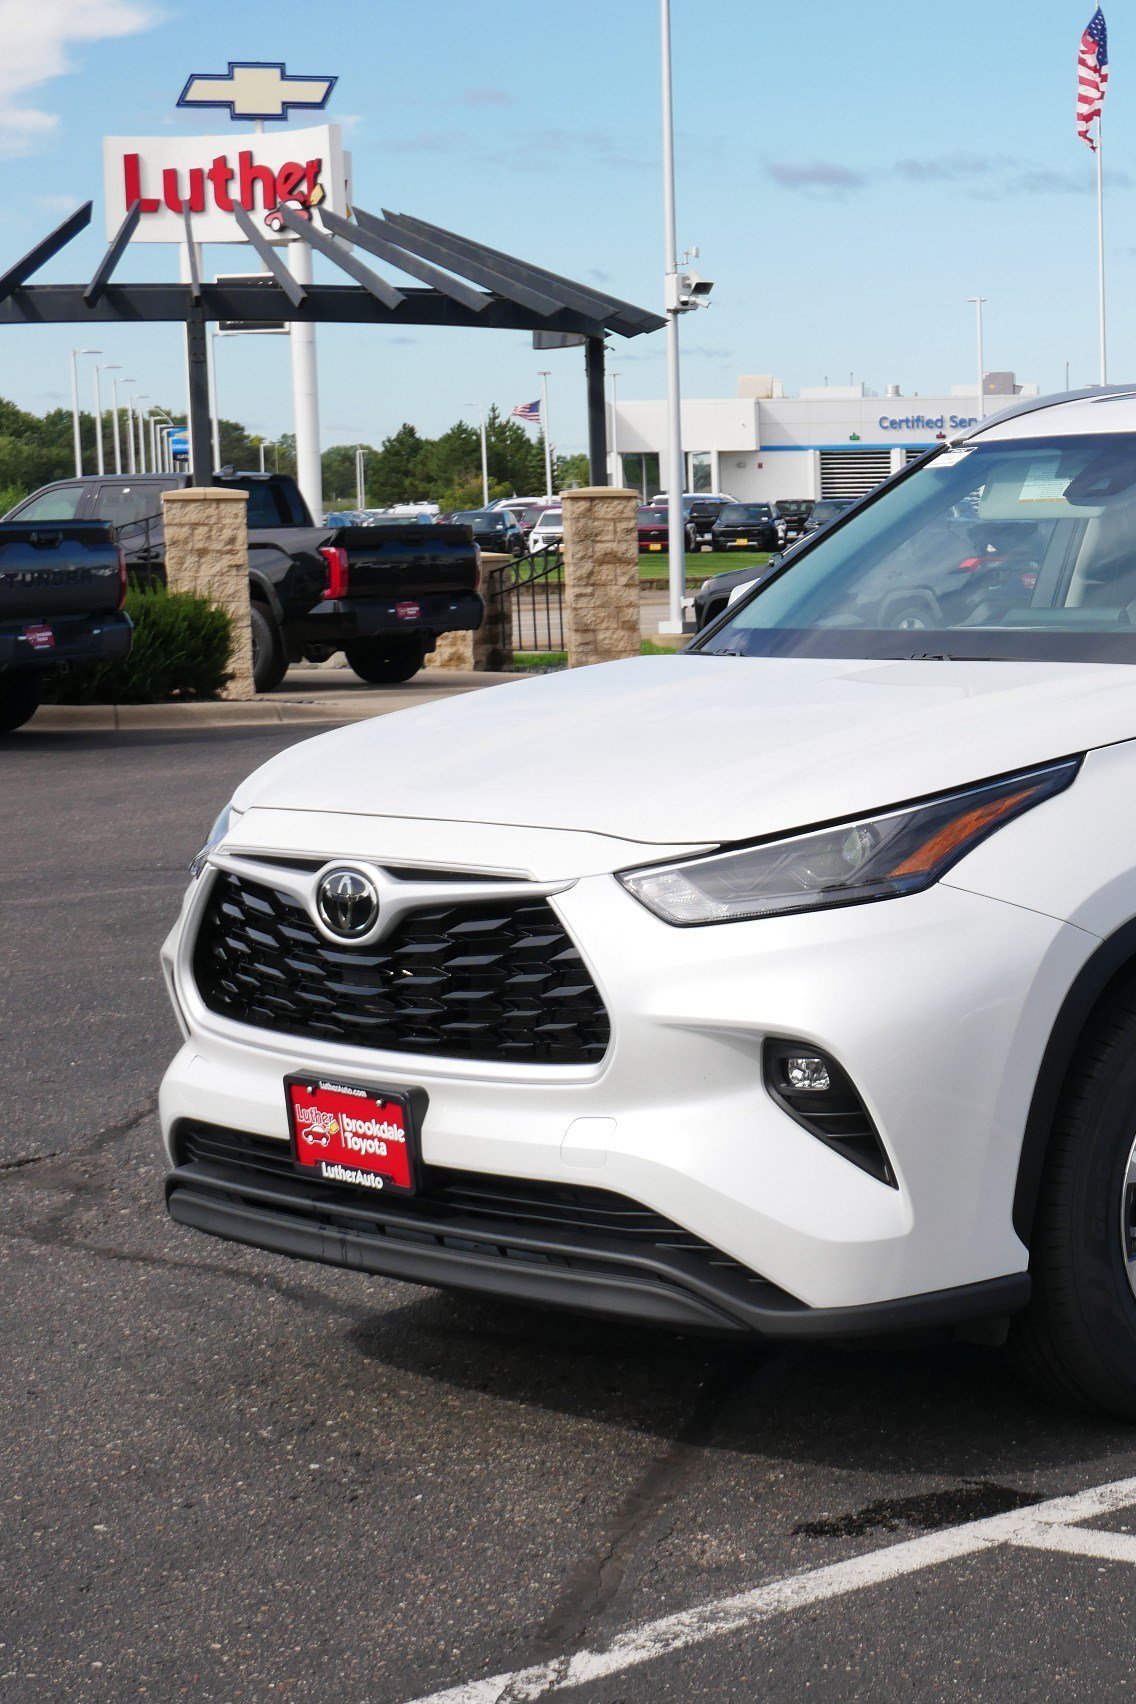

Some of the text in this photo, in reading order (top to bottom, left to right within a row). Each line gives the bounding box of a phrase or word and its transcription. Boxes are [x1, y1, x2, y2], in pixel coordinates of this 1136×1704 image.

[123, 150, 323, 213] Luther
[878, 414, 978, 430] Certified Ser
[295, 1103, 335, 1126] Luther
[342, 1113, 406, 1143] brookdale
[344, 1131, 388, 1156] Toyota
[321, 1161, 384, 1190] LutherAuto
